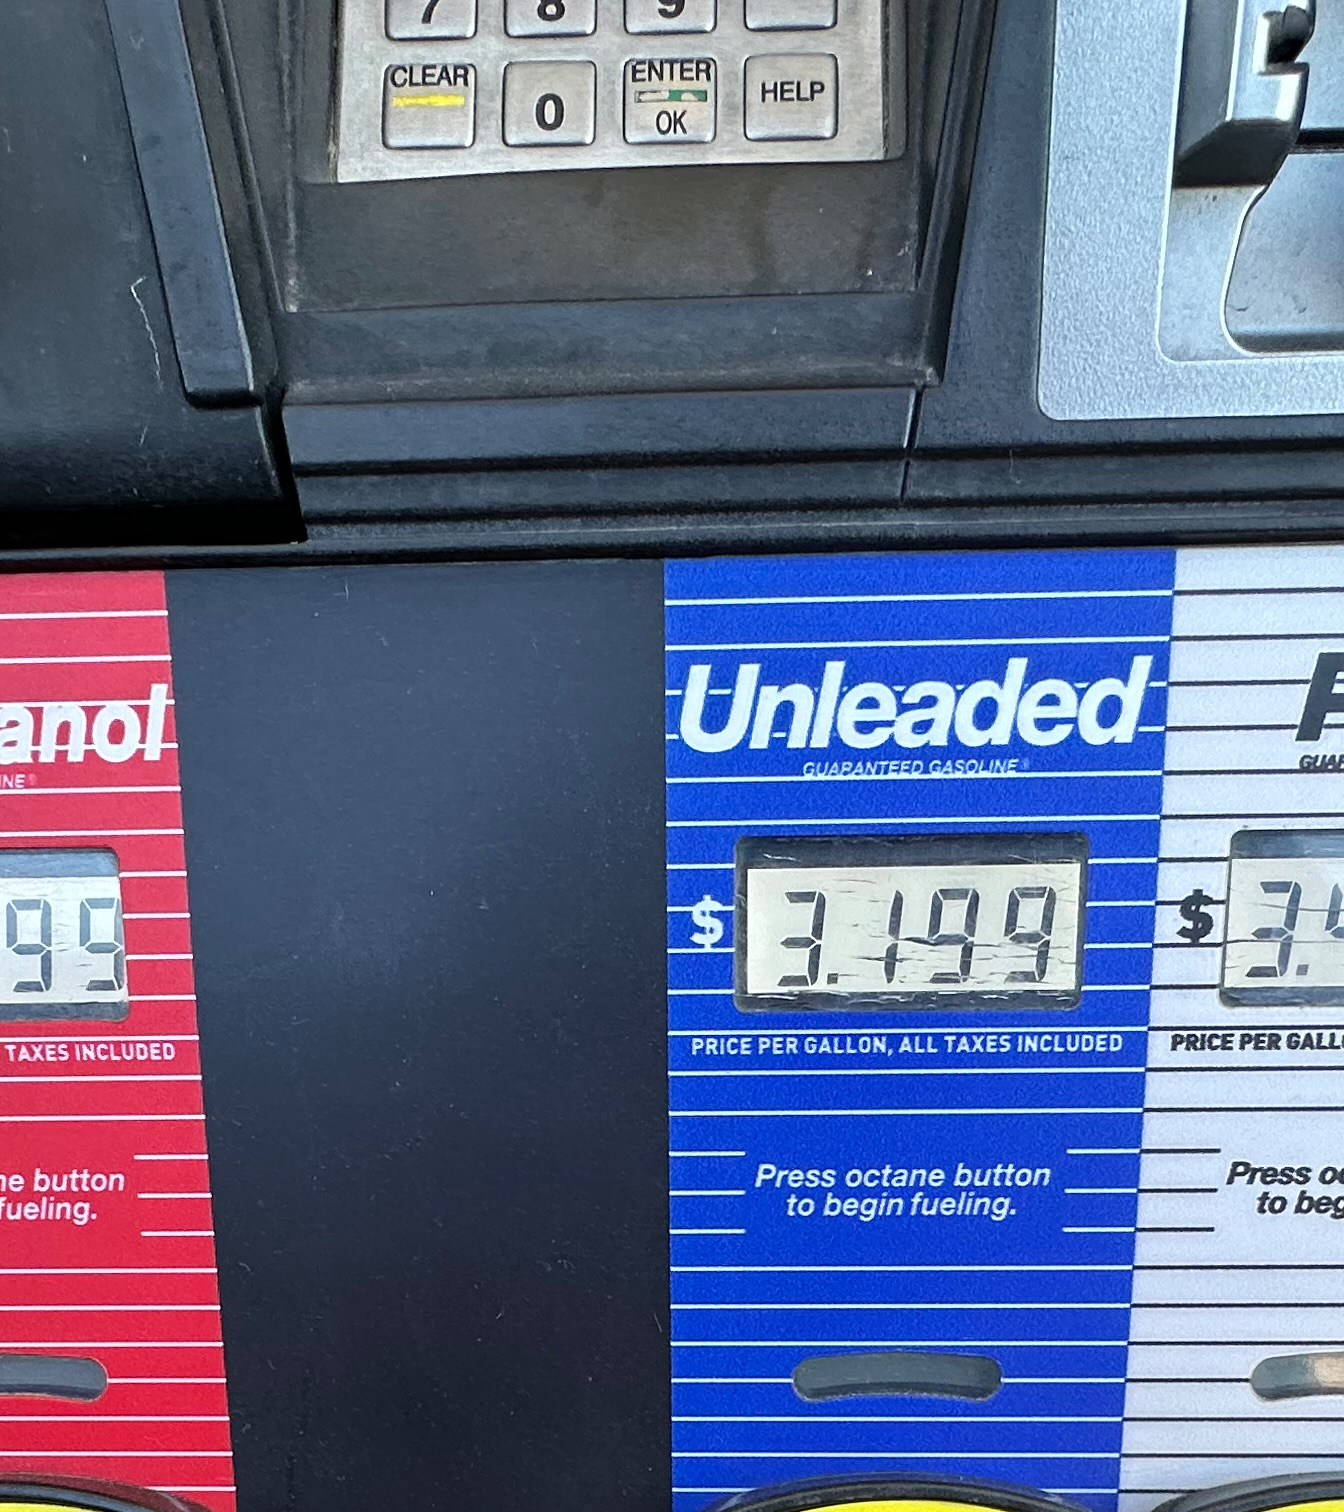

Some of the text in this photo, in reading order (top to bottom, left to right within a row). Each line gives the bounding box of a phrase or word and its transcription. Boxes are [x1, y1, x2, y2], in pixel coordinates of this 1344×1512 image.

[390, 65, 470, 88] CLEAR
[631, 61, 712, 83] ENTER
[761, 80, 825, 103] HELP
[535, 94, 565, 131] 0
[655, 110, 688, 135] OK
[679, 655, 1153, 753] Unleaded
[803, 760, 924, 777] GUARANTEED
[1177, 889, 1214, 945] $
[689, 886, 1056, 987] $ 3.199
[5, 1044, 69, 1062] TAXES
[74, 1042, 176, 1061] INCLUDED
[691, 1034, 1123, 1057] PRICE PER GALLON, ALL TAXES INCLUDED
[1171, 1034, 1234, 1052] PRICE
[1239, 1033, 1283, 1052] PER
[33, 1168, 126, 1193] button
[755, 1163, 1051, 1188] Press octane button
[1227, 1161, 1311, 1186] Press
[786, 1191, 1017, 1223] to begin fueling.
[1256, 1191, 1287, 1215] to
